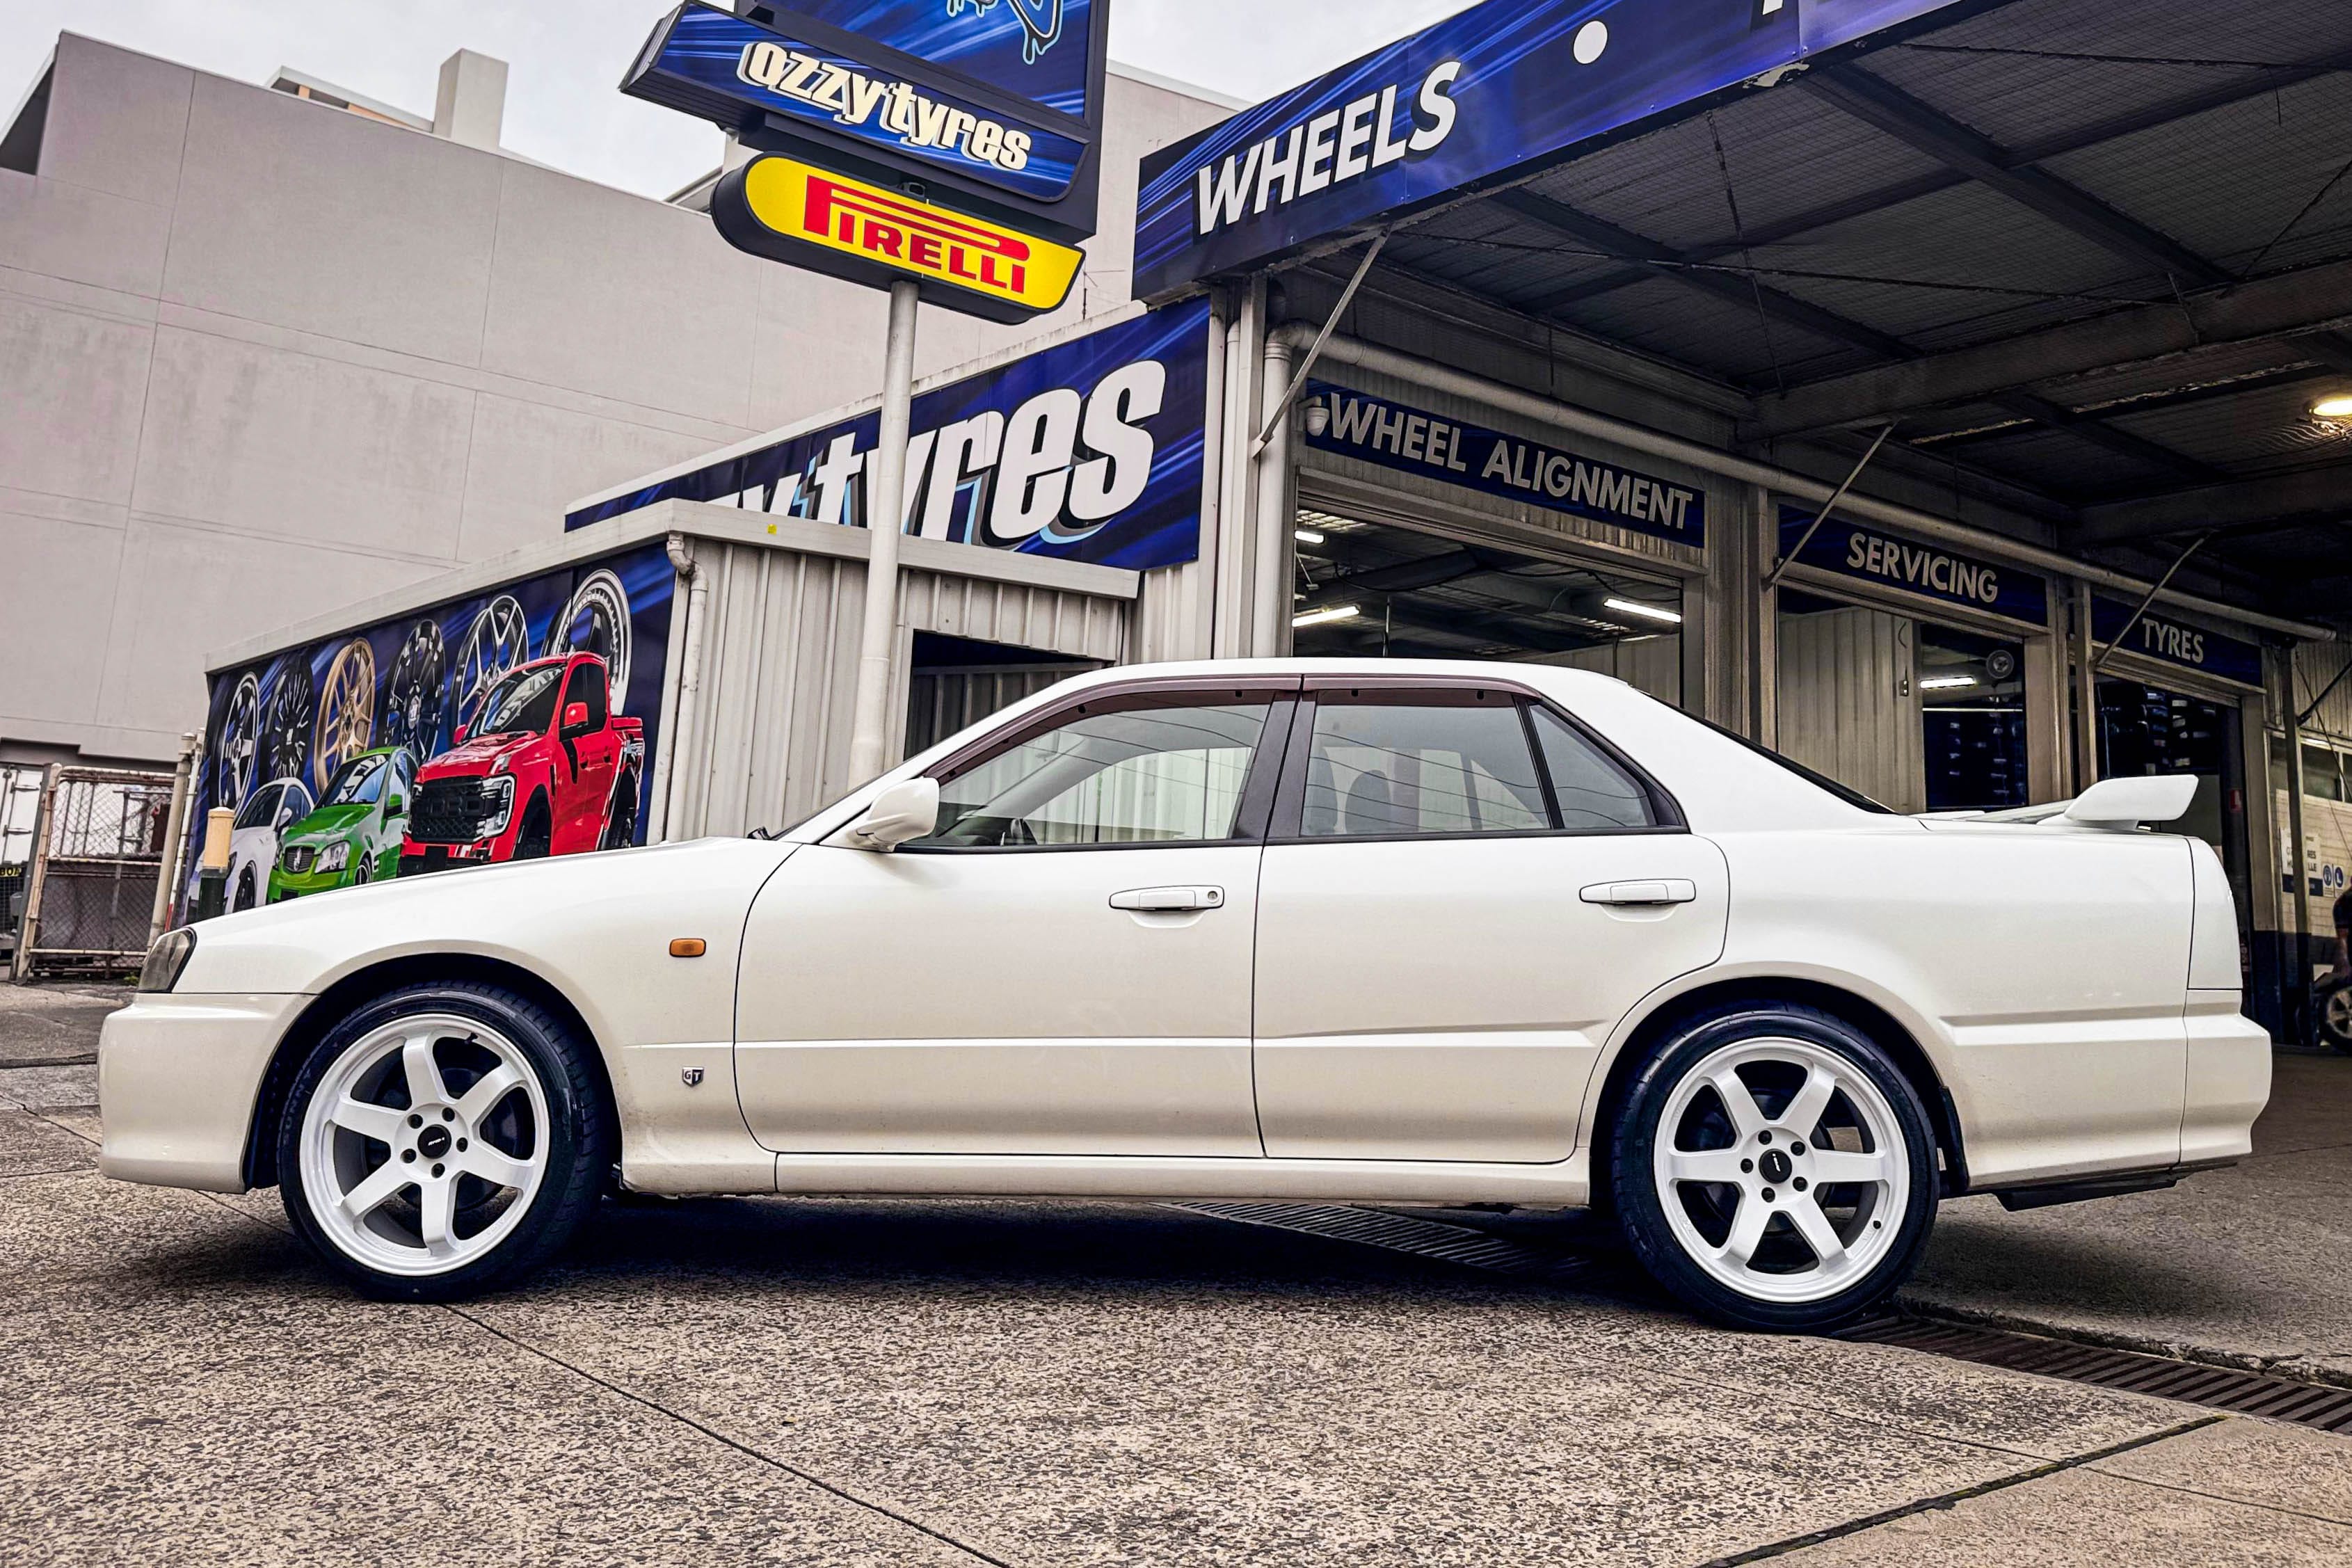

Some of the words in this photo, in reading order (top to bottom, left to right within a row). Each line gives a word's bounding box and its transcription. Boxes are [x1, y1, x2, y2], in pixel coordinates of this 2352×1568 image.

[1198, 60, 1461, 235] WHEELS
[803, 174, 1031, 294] PIRELLI
[1330, 392, 1466, 472] WHEEL
[1481, 439, 1693, 529] ALIGNMENT
[1846, 532, 1998, 603] SERVICING
[2142, 618, 2204, 664] TYRES
[684, 1071, 701, 1082] GT
